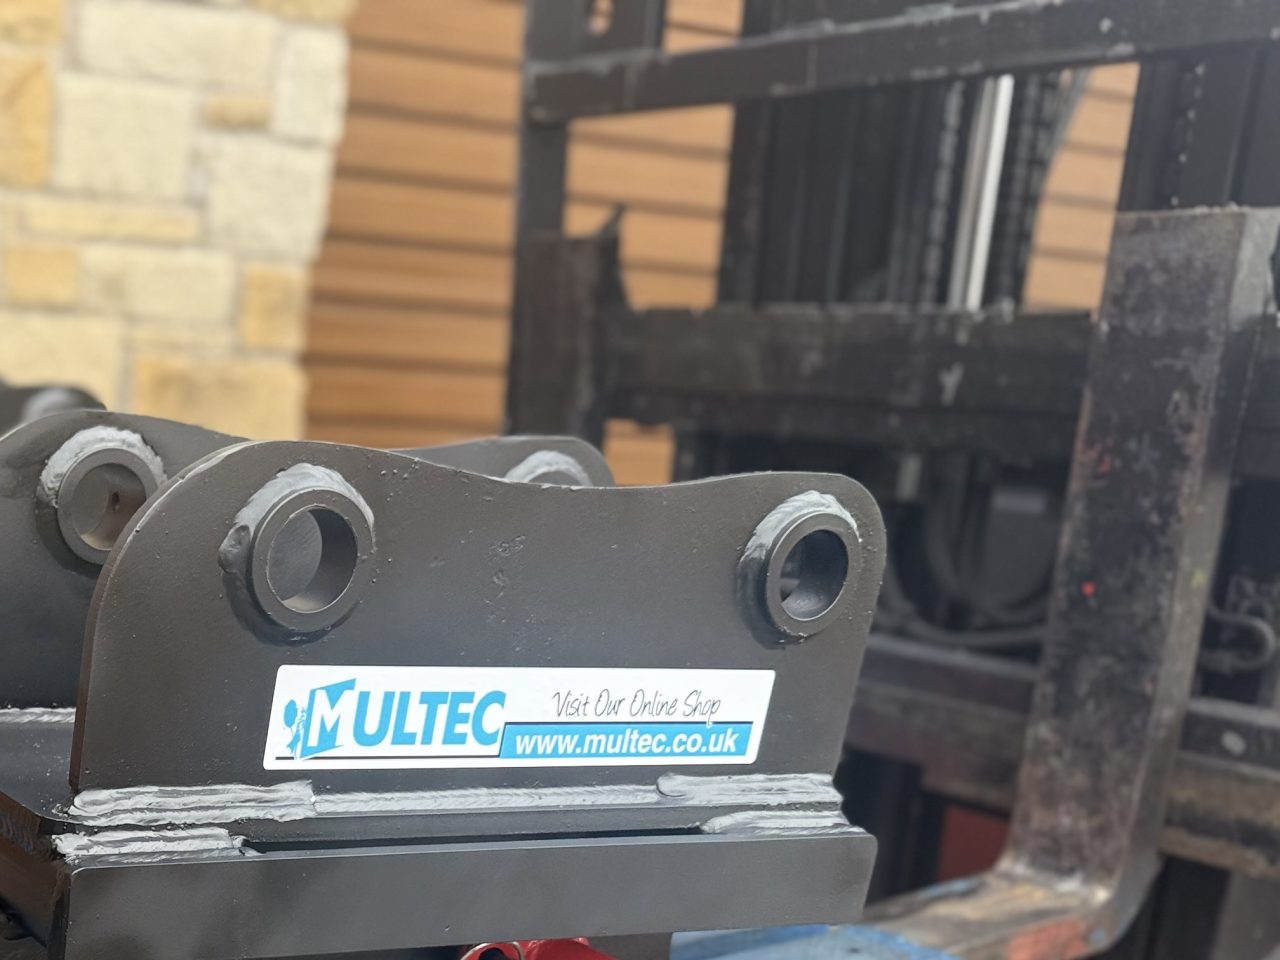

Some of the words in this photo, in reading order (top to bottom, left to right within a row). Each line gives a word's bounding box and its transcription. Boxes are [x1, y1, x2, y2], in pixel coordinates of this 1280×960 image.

[304, 682, 507, 751] MULTEC
[552, 689, 590, 717] Visit
[594, 688, 625, 717] Our
[629, 688, 678, 717] Online
[683, 689, 721, 728] Shop
[515, 727, 739, 756] www.multec.co.uk
